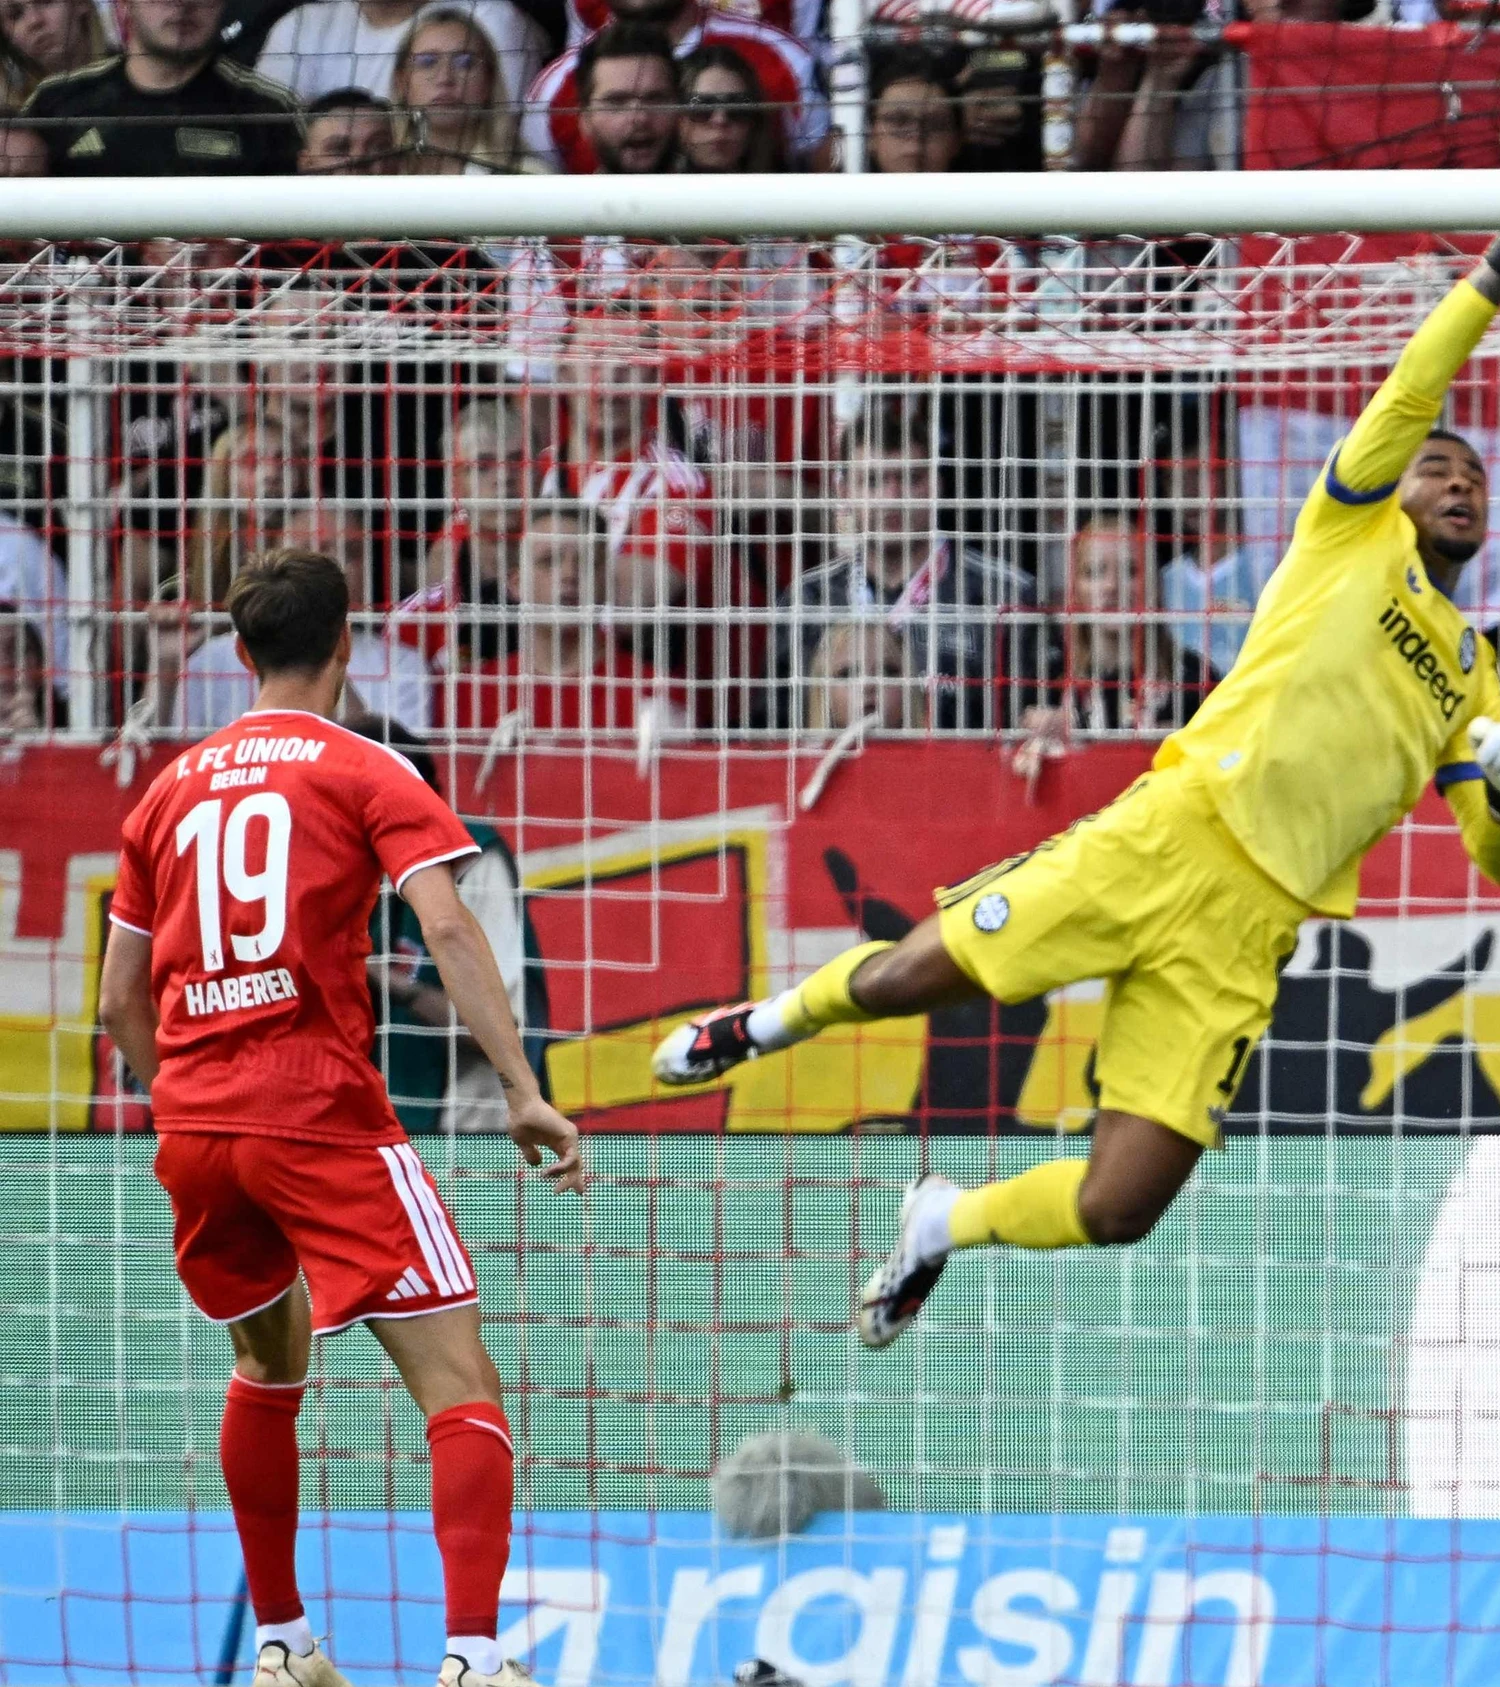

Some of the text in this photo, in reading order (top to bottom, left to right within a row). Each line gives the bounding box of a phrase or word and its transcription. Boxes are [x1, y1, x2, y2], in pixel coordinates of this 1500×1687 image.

[1379, 597, 1465, 722] indeed
[176, 736, 327, 780] 1. FC UNION
[209, 766, 268, 791] BERLIN
[175, 792, 292, 972] 19
[185, 967, 299, 1017] HABERER
[1217, 1035, 1250, 1094] 1
[657, 1525, 1275, 1687] raisin
